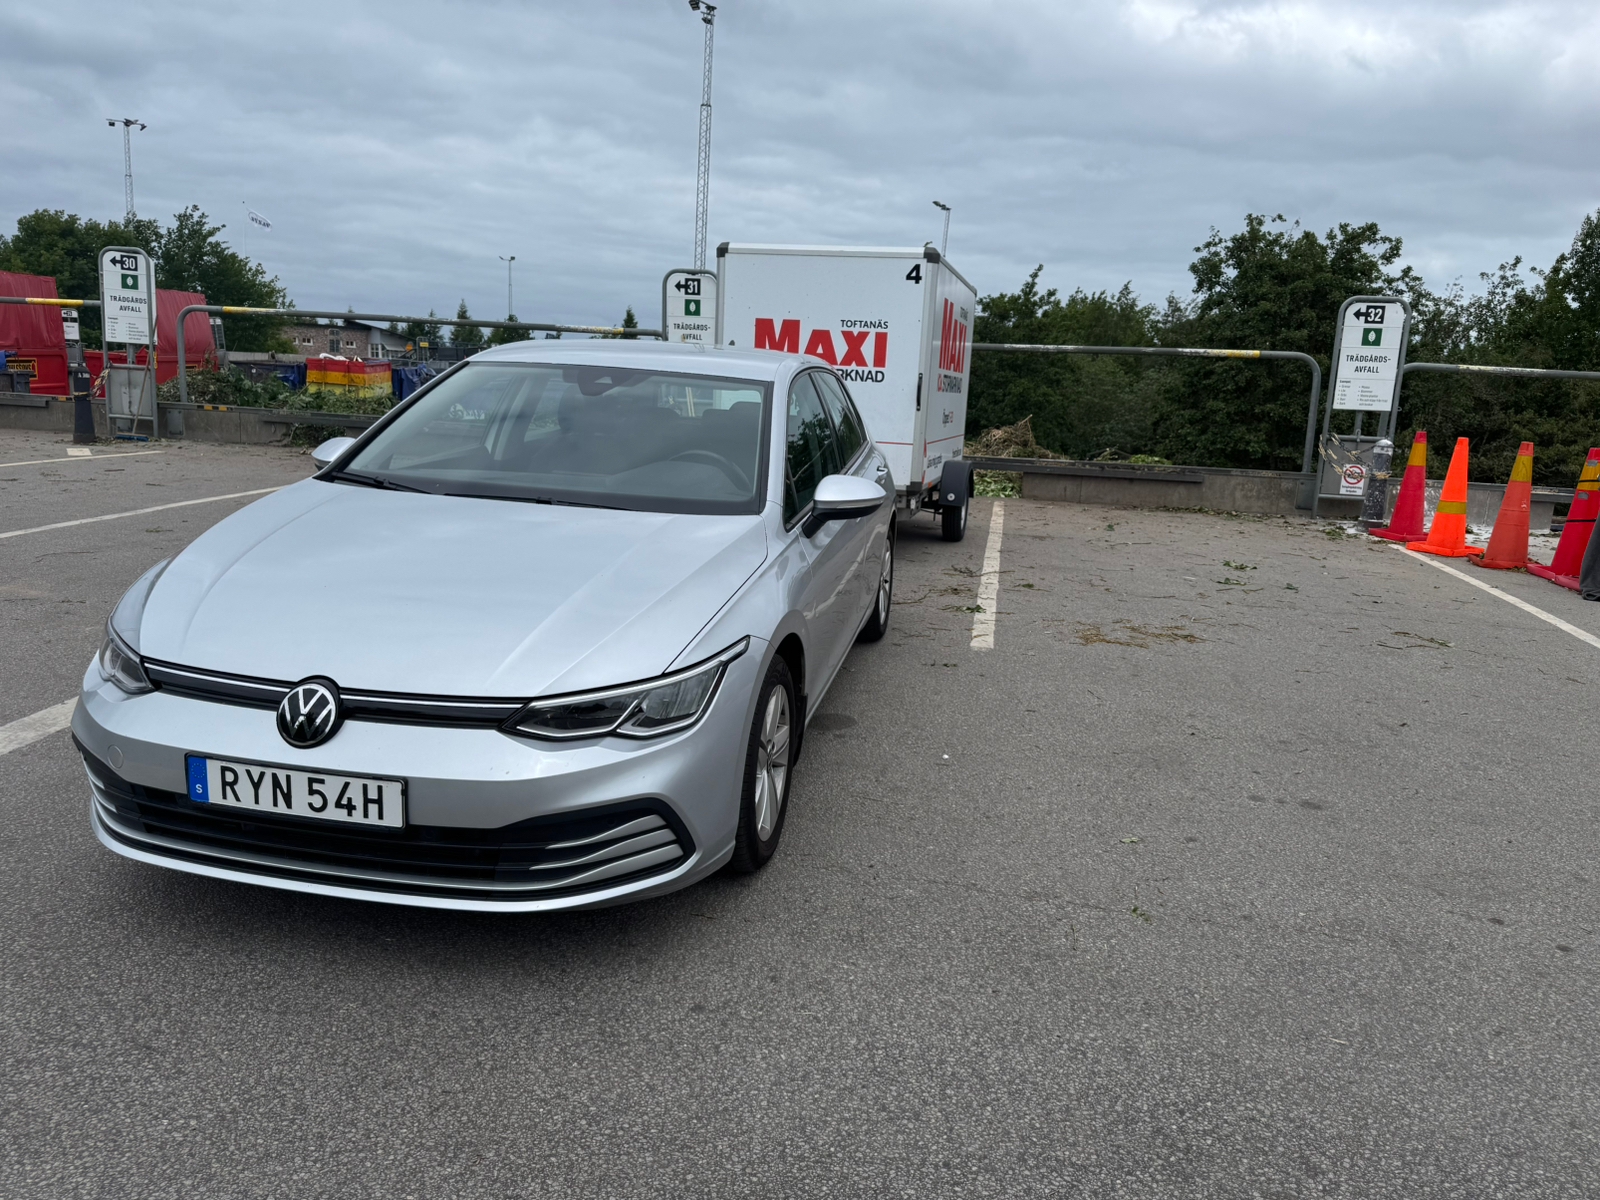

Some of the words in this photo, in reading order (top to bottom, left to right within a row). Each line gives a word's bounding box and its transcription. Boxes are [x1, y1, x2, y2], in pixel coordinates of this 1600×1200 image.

[122, 257, 136, 270] 30
[905, 263, 922, 285] 4
[687, 280, 698, 294] 31
[119, 304, 142, 313] AVFALL
[1366, 307, 1383, 322] 32
[673, 322, 711, 331] TRÄDGÅRDS-
[840, 319, 889, 329] TOFTANÄS
[939, 297, 967, 374] MAXI
[755, 317, 888, 368] MAXI
[1345, 354, 1391, 364] TRÄDGÅRDS-
[1354, 365, 1380, 374] AVFALL
[195, 784, 203, 794] S
[220, 765, 293, 810] RYN
[307, 777, 384, 820] 54H
